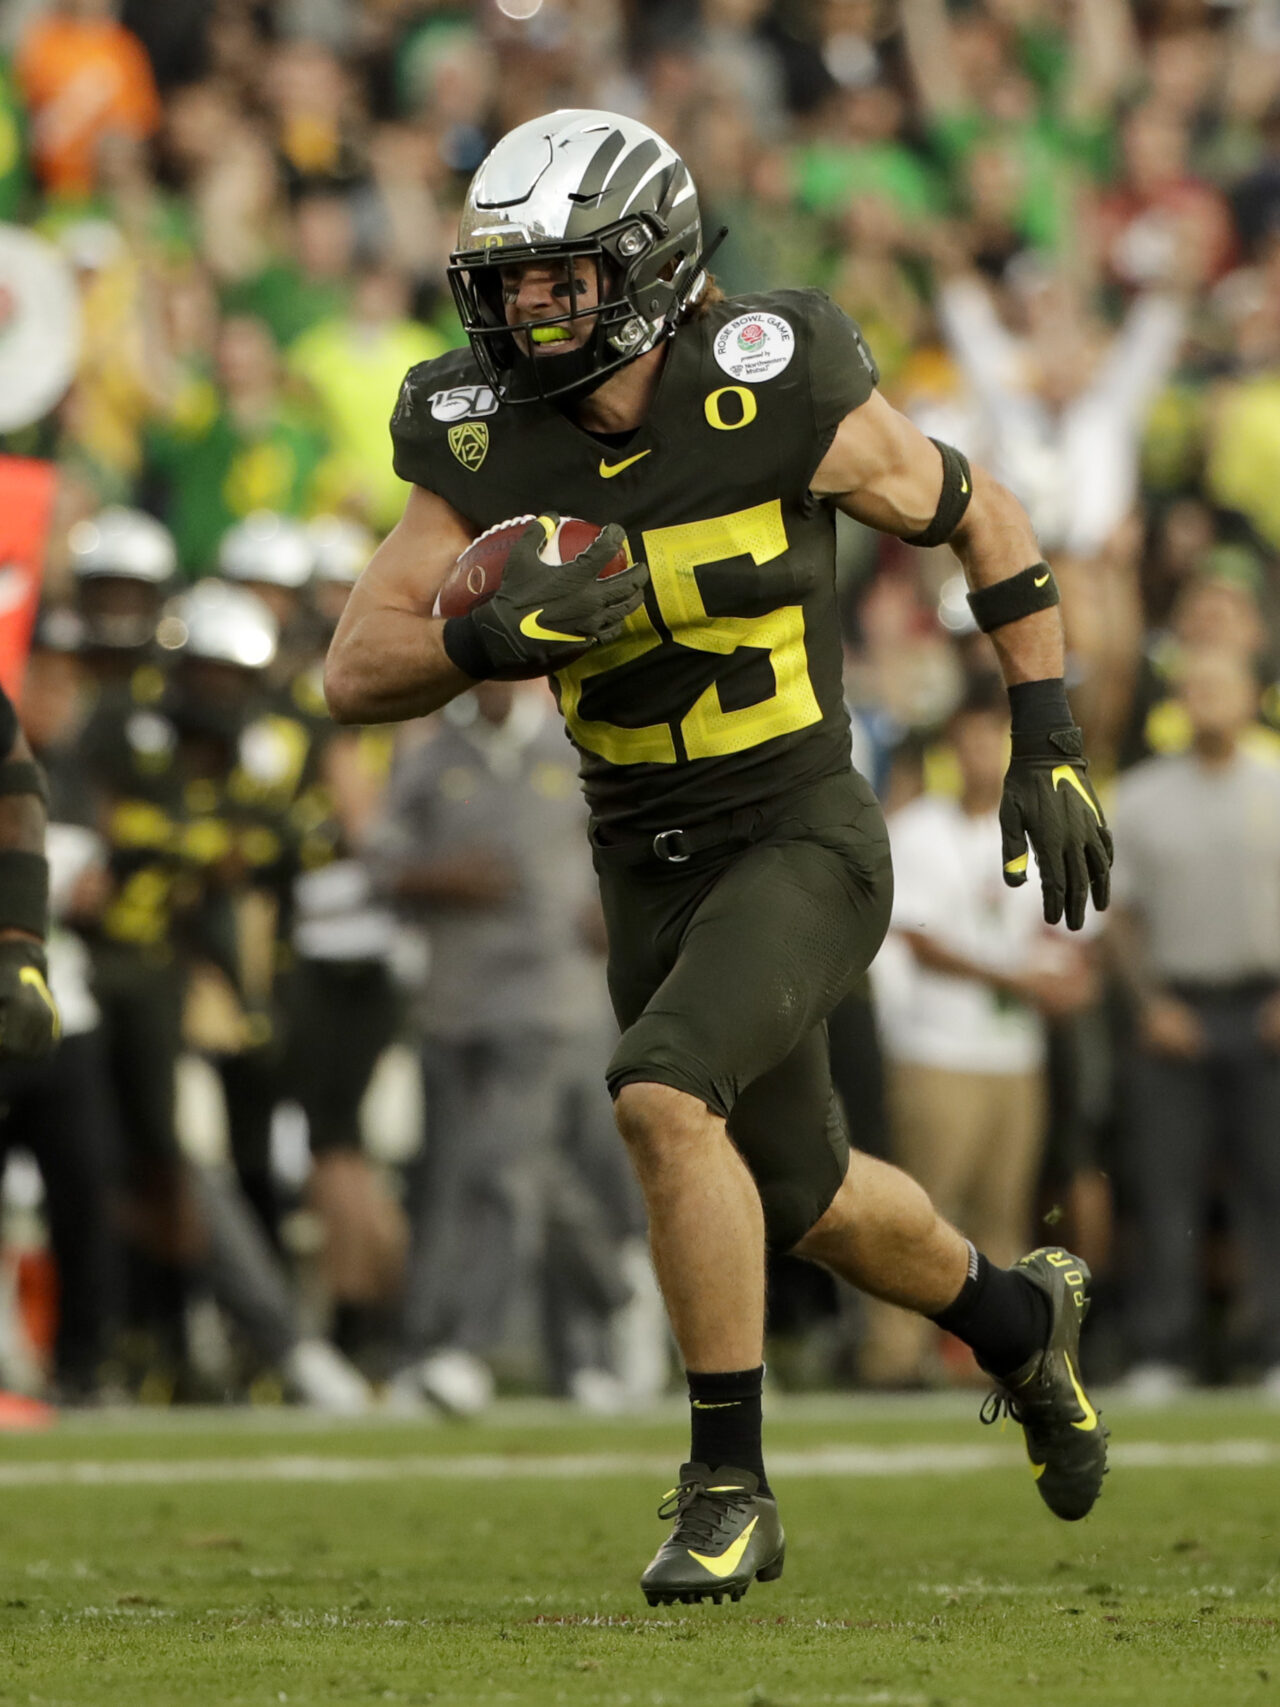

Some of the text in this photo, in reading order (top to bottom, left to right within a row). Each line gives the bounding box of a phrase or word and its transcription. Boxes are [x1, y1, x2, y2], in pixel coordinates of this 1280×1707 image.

[717, 315, 790, 355] ROSE BOWL GAME
[427, 384, 507, 422] 150
[704, 386, 757, 430] O
[450, 424, 487, 455] PAC
[461, 442, 482, 463] 12
[552, 498, 824, 766] 25
